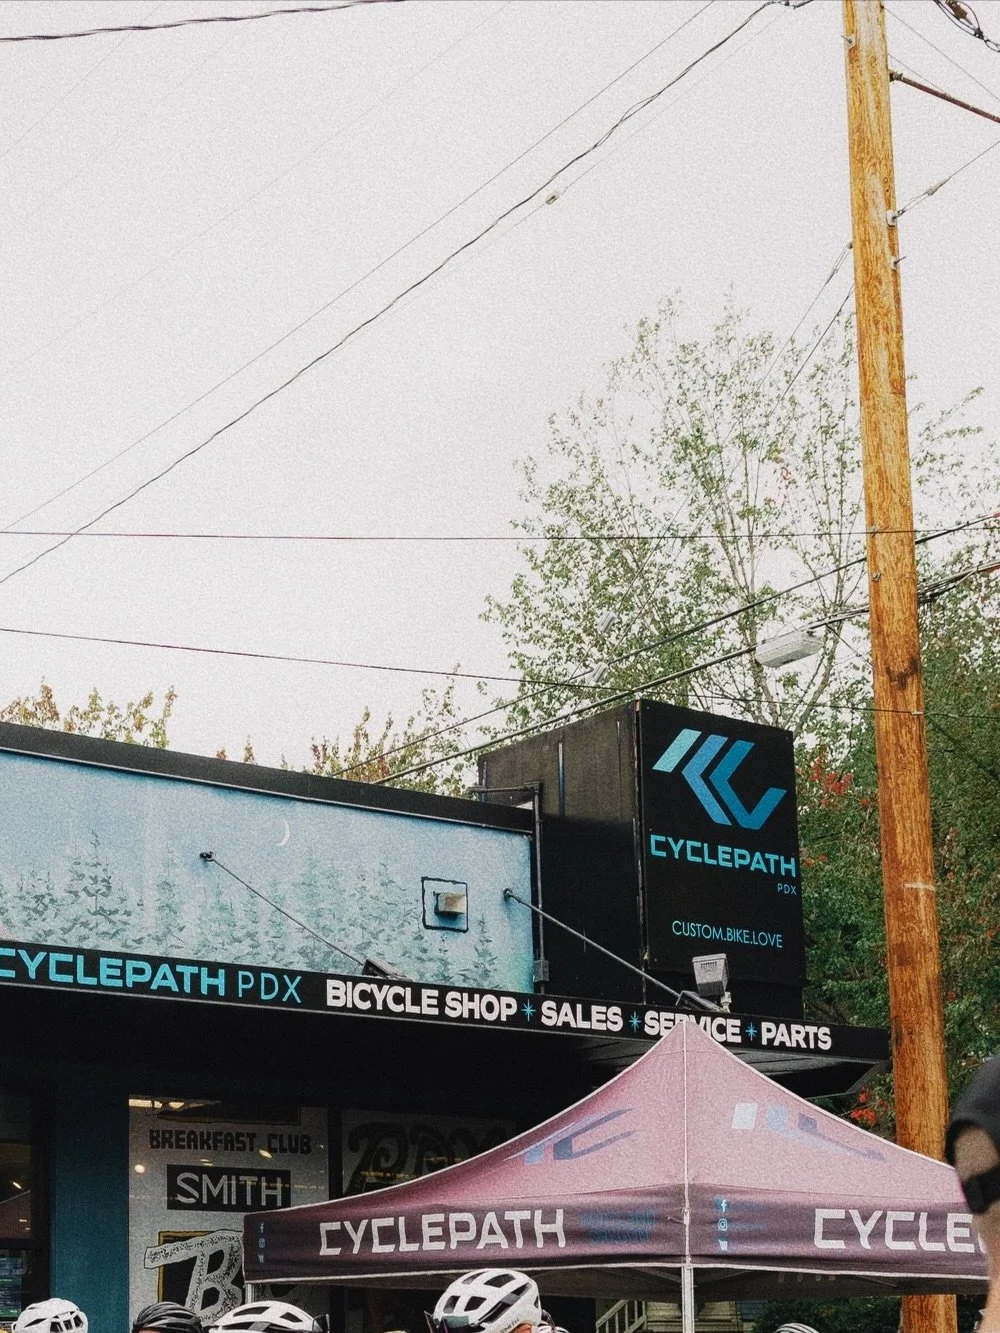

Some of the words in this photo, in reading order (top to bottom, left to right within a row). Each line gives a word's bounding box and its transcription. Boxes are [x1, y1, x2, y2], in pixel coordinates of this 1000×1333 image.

[650, 834, 796, 878] CYCLEPATH
[777, 882, 797, 896] PDX
[671, 920, 783, 948] CUSTOM.BIKE.LOVE
[238, 970, 302, 1003] PDX
[326, 979, 439, 1015] BICYCLE
[444, 991, 518, 1021] SHOP
[541, 1000, 624, 1032] SALES
[644, 1010, 742, 1043] SEICE
[761, 1021, 832, 1051] PARTS
[149, 1129, 257, 1151] BREAKFAST
[267, 1133, 312, 1155] CLUB
[176, 1171, 282, 1207] SMITH
[319, 1208, 566, 1256] CYCLEPATH
[814, 1208, 986, 1254] CYCLE
